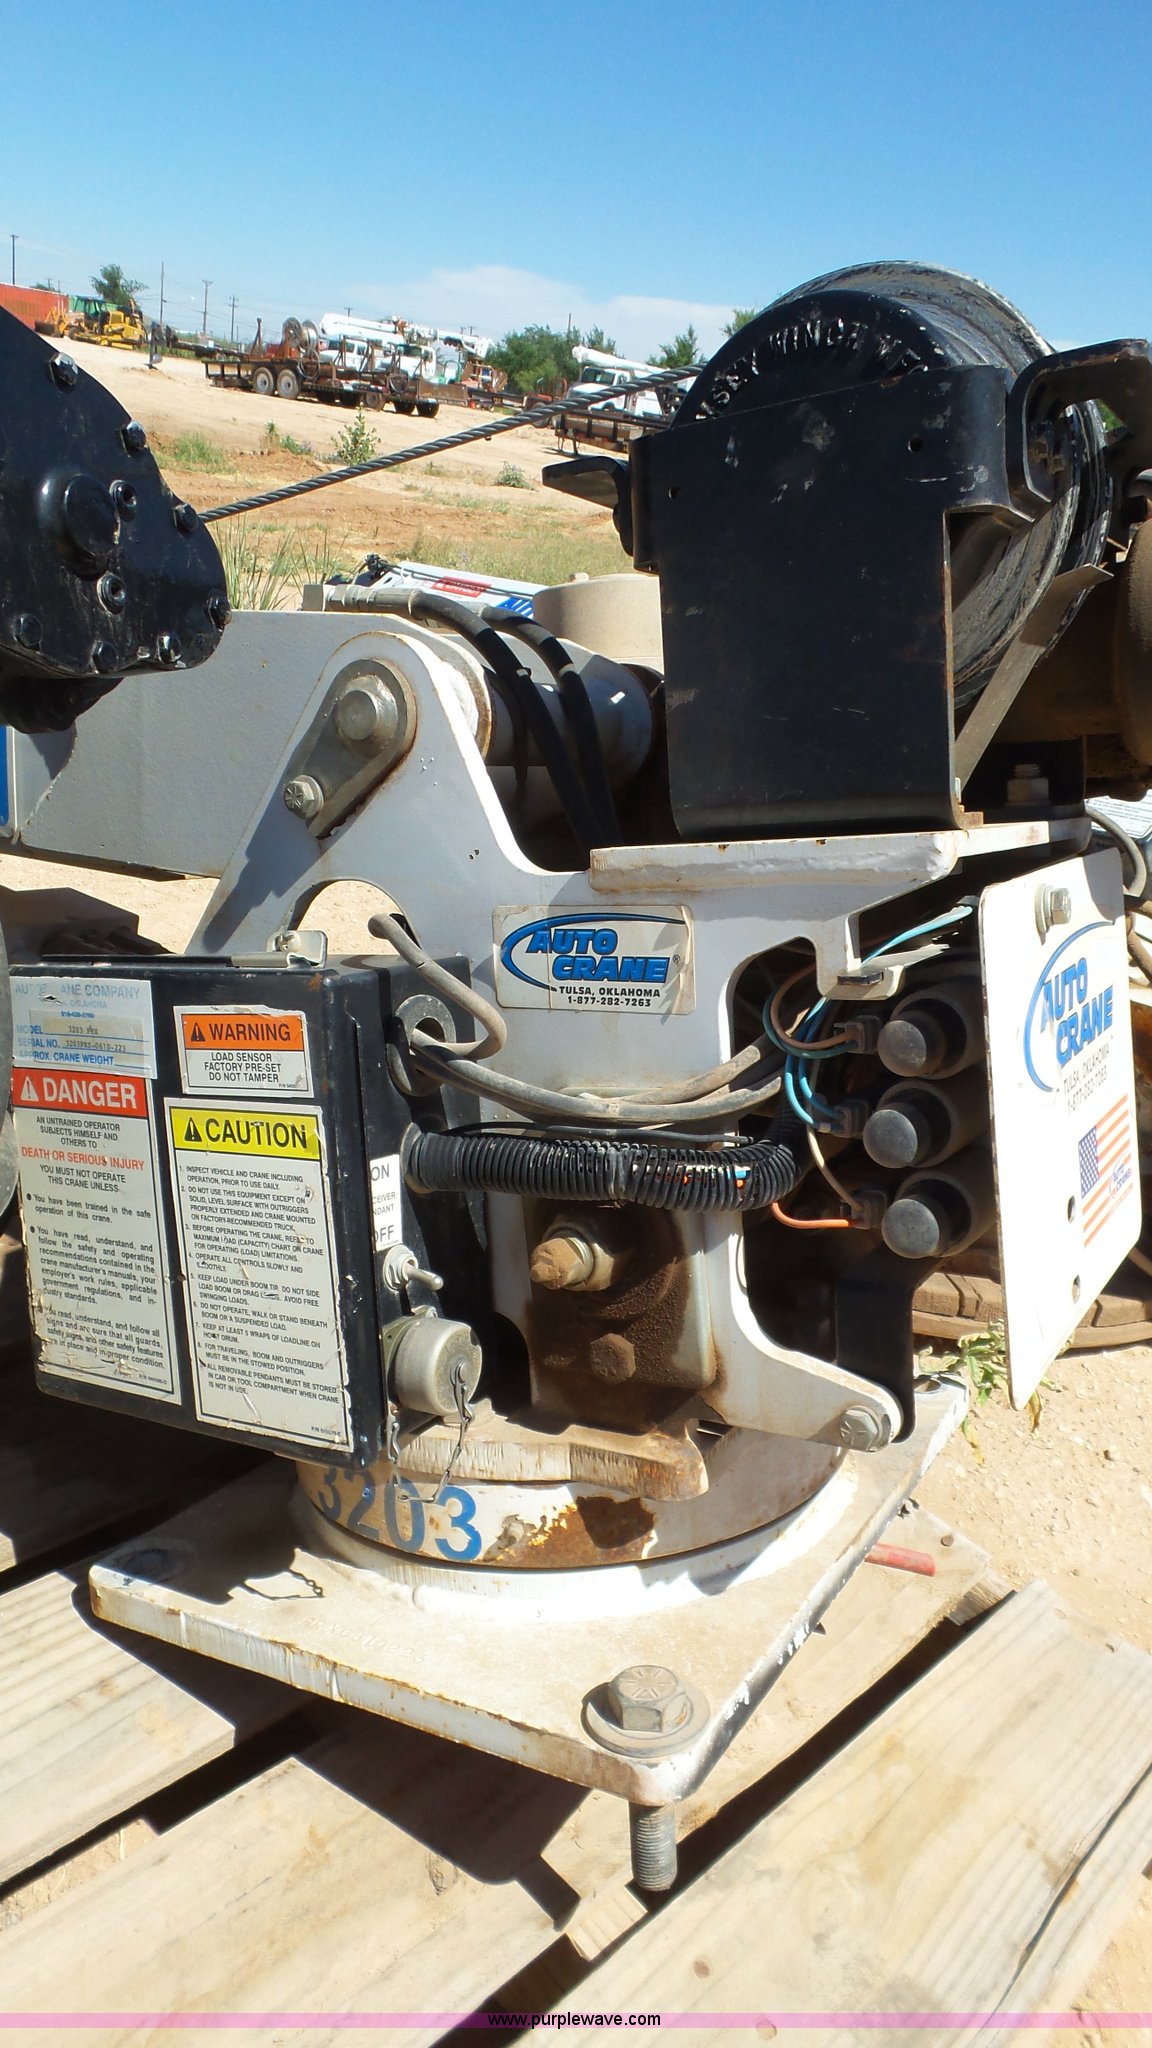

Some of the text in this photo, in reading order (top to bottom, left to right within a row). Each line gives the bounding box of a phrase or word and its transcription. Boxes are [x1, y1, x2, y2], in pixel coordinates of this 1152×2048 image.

[525, 928, 618, 955] AUTO
[552, 955, 670, 983] CRANE
[85, 985, 140, 998] COMPANY
[559, 986, 660, 998] TULSA, OKLAHOMA
[1040, 957, 1088, 1034] AUTO
[568, 996, 651, 1007] 1-877-282-7263
[16, 1025, 43, 1035] MODEL
[209, 1023, 291, 1041] WARNING
[1056, 985, 1113, 1069] CRANE
[17, 1039, 44, 1048] SERIAL
[46, 1039, 60, 1048] NO.
[54, 1052, 80, 1062] CRANE
[82, 1054, 114, 1065] WEIGHT
[211, 1052, 272, 1062] LOAD SENSOR
[204, 1062, 281, 1073] FACTORY PRE-SET
[209, 1072, 279, 1083] DO NOT TAMPER
[42, 1077, 137, 1109] DANGER
[46, 1117, 82, 1127] UNTRAINED
[83, 1120, 120, 1131] OPERATOR
[40, 1125, 118, 1140] SUBJECTS HIMSELF AND
[205, 1118, 307, 1149] CAUTION
[60, 1137, 97, 1148] OTHERS TO
[21, 1146, 144, 1170] DEATH OR SERIOUS INJURY
[39, 1164, 125, 1182] YOU MUST NOT OPERATE
[370, 1163, 390, 1181] ON
[47, 1175, 119, 1192] THIS CRANE UNLESS
[319, 1468, 482, 1562] 3203
